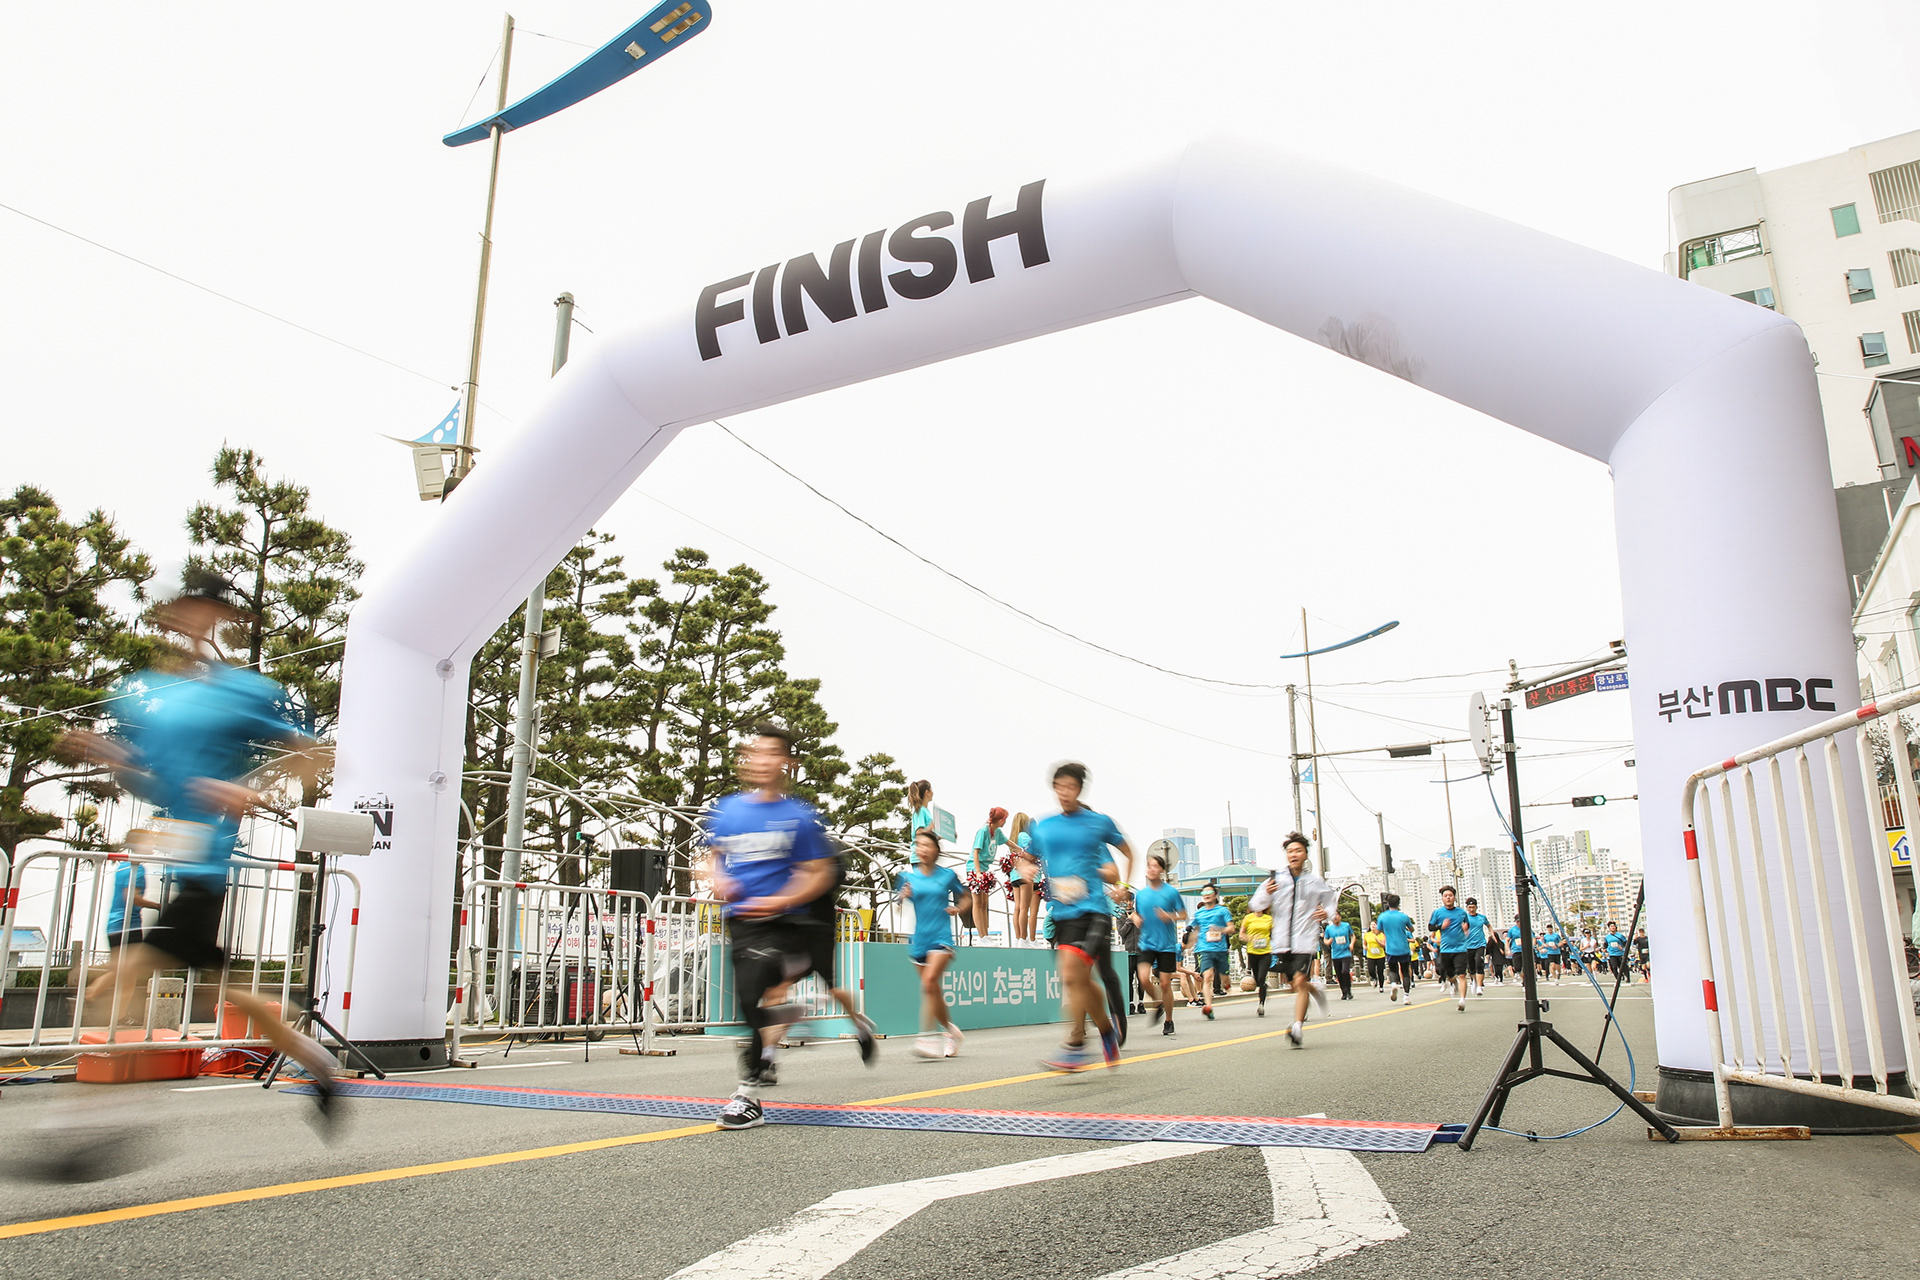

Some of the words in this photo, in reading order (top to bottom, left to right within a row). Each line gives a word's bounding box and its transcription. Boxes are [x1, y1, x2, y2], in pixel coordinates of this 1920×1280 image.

[695, 179, 1051, 361] FINISH
[1658, 685, 1714, 723] 부산
[942, 970, 987, 1007] 당신의
[992, 966, 1037, 1005] 초능력
[1045, 970, 1060, 999] kt
